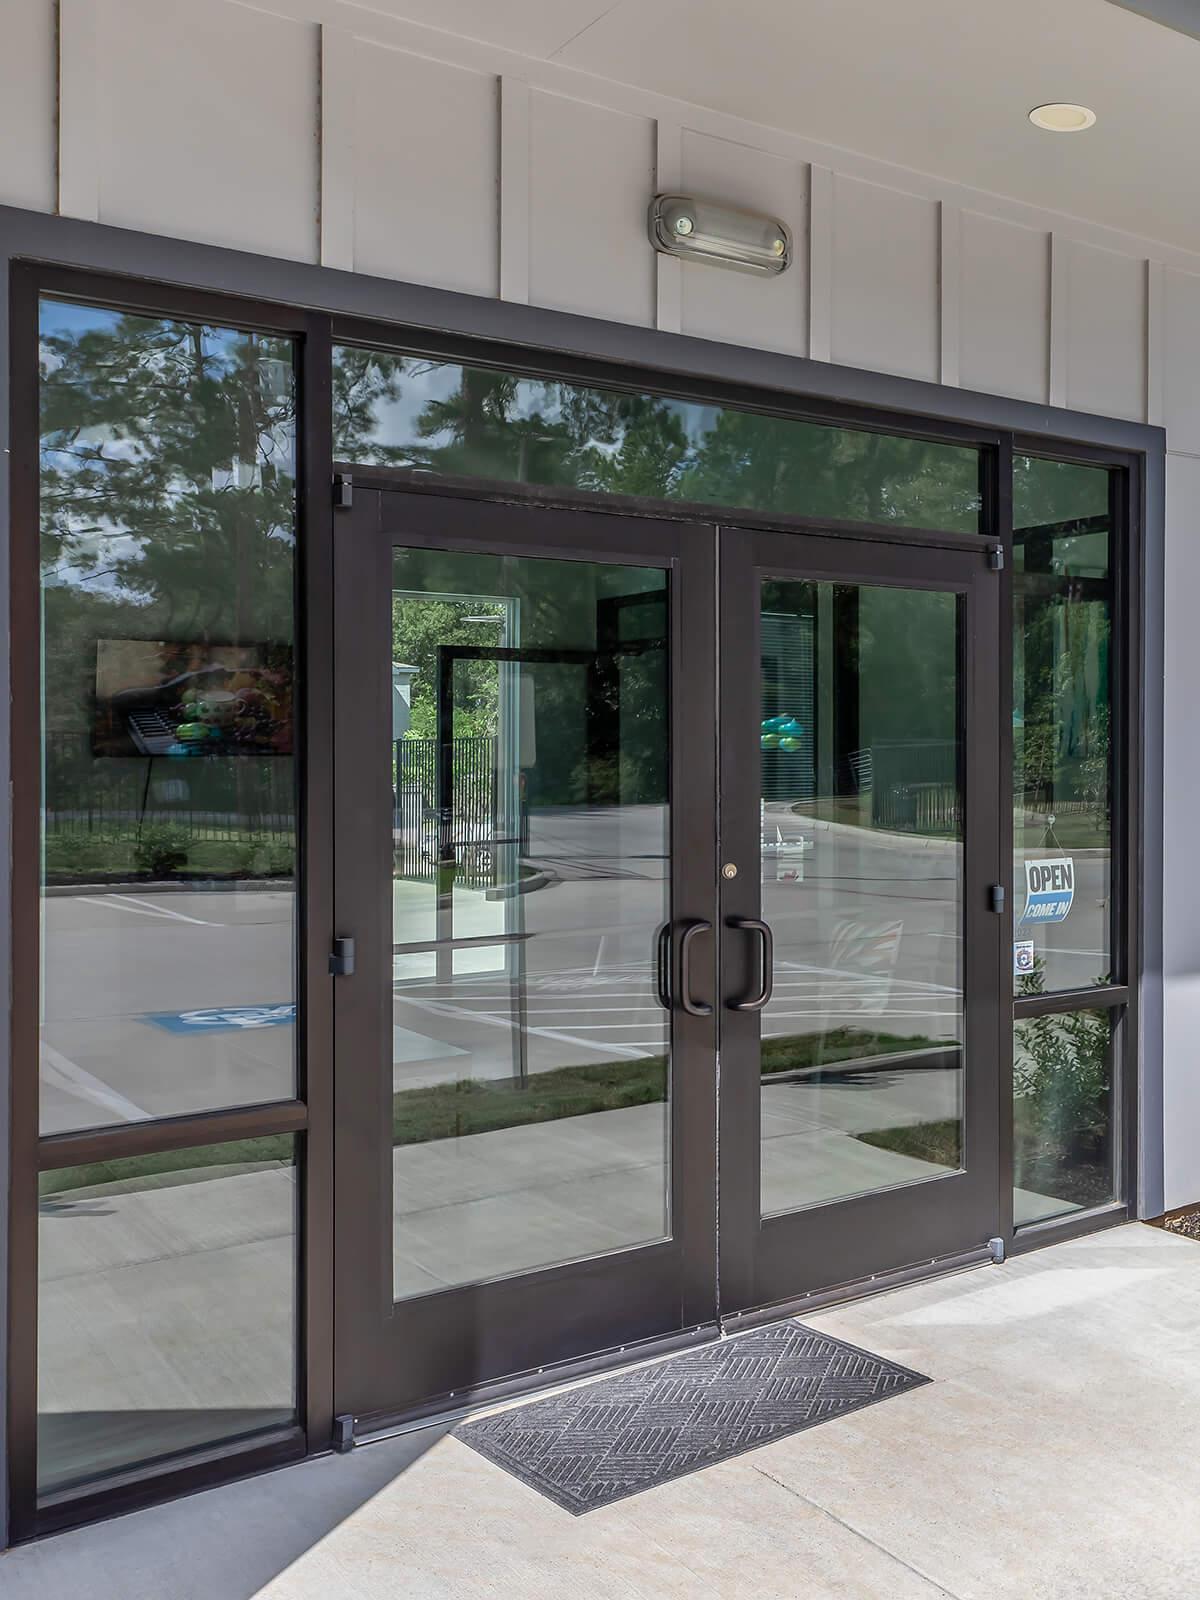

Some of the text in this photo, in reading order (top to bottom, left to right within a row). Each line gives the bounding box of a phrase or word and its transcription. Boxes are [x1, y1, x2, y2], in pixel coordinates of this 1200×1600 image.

[1029, 864, 1072, 893] OPEN
[1026, 901, 1069, 918] COME IN
